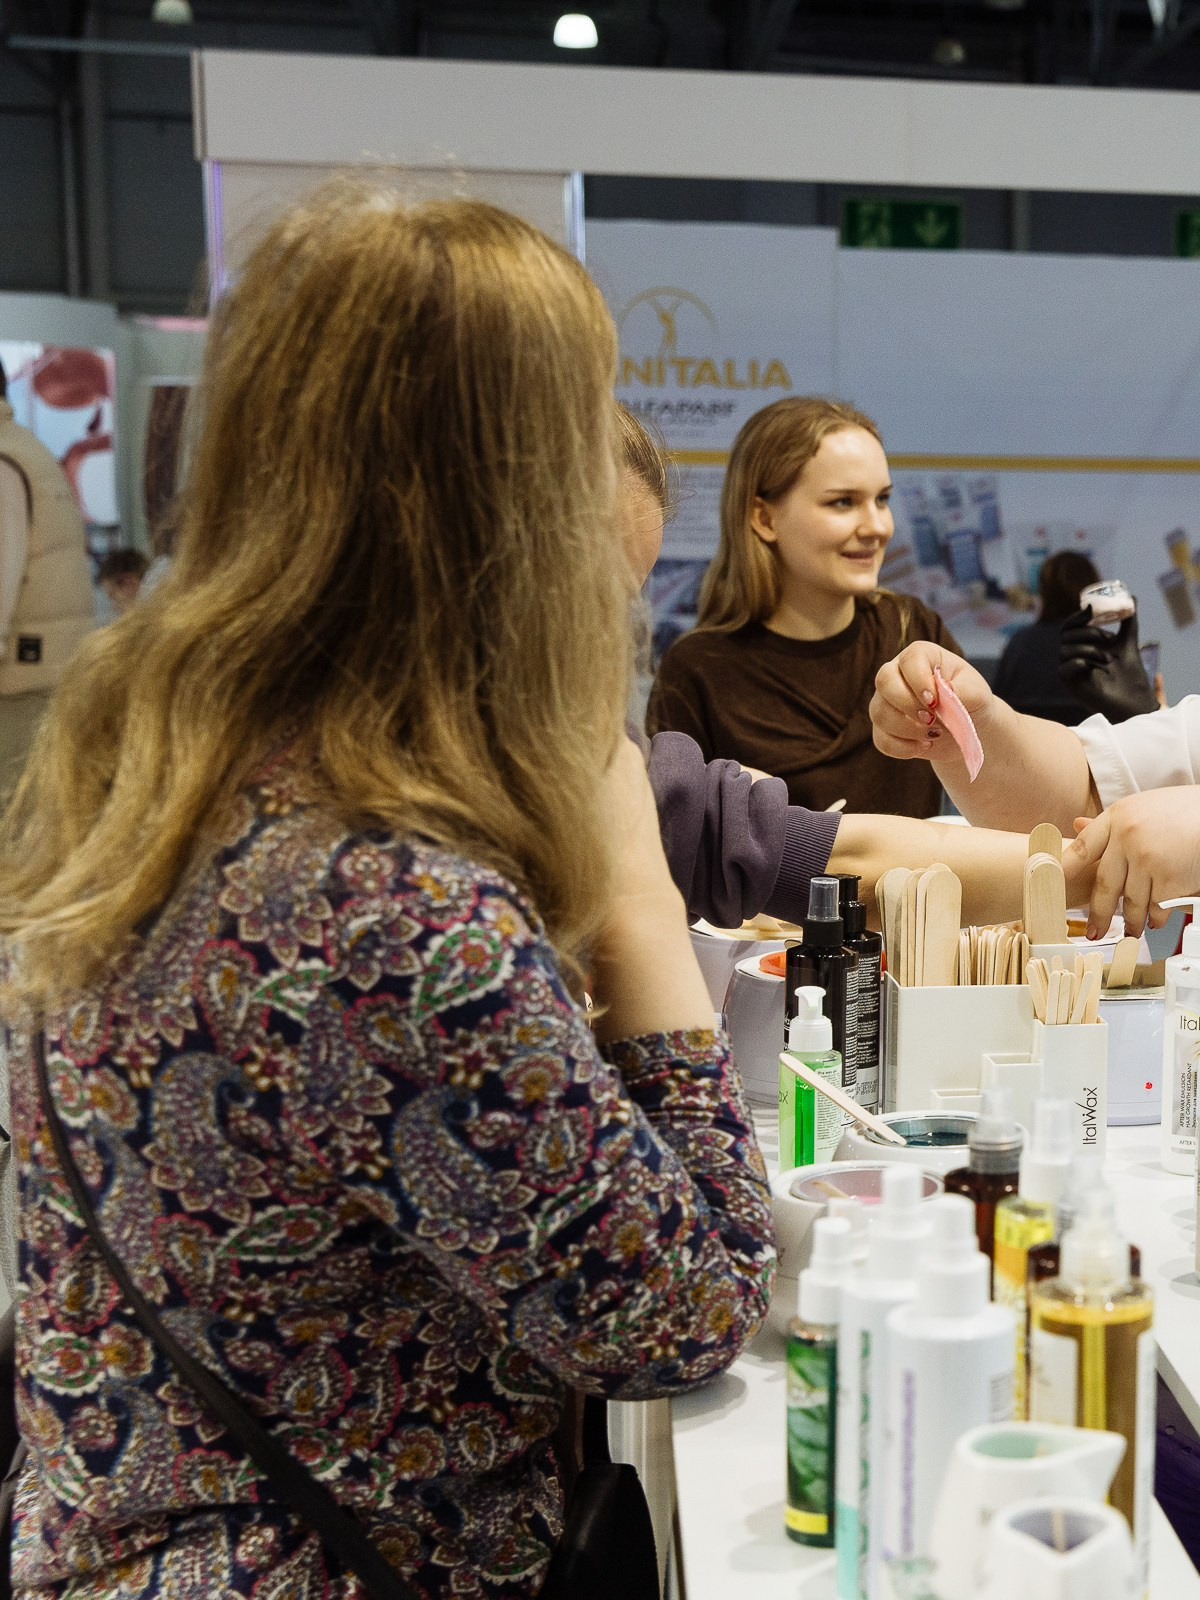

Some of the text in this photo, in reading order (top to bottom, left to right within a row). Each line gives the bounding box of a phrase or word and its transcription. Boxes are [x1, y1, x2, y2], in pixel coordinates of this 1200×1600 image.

[618, 355, 793, 389] NITALIA
[1074, 1087, 1098, 1145] ItalWax
[1179, 1139, 1193, 1147] AFTER
